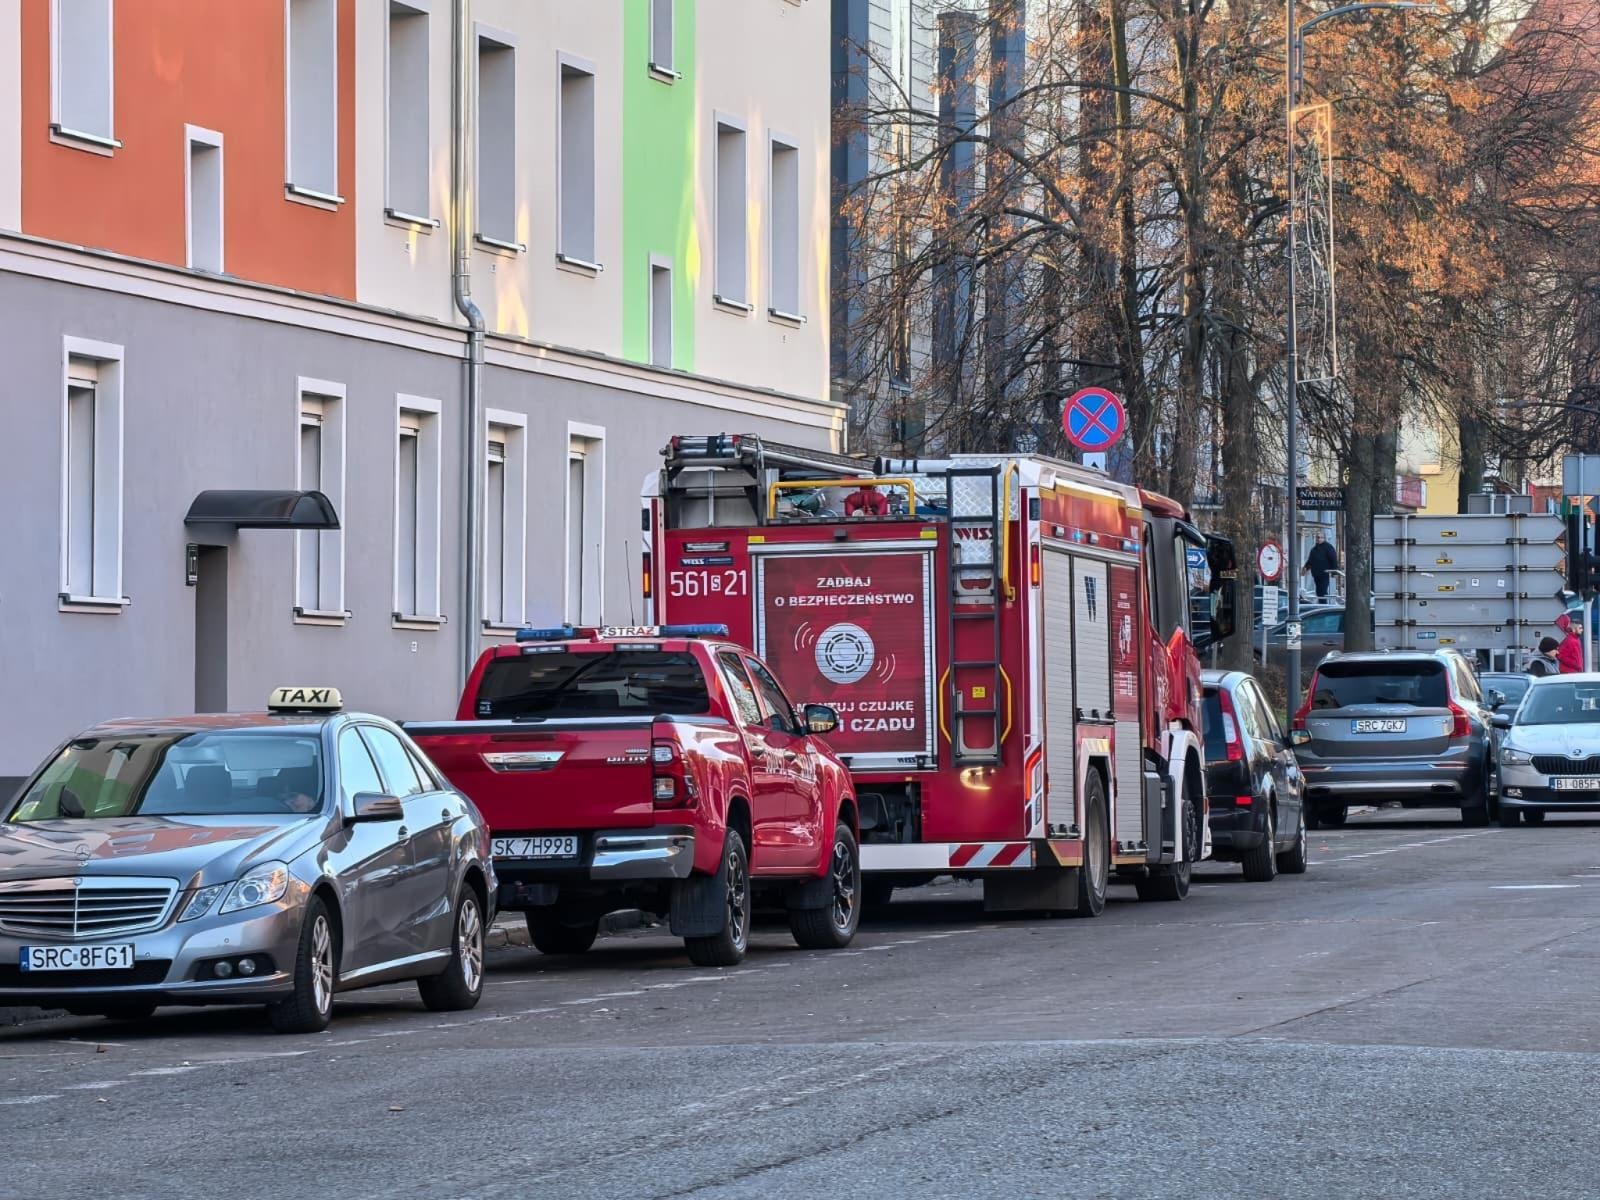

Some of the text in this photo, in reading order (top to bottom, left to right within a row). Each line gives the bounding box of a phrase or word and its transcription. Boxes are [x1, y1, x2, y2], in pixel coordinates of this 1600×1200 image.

[670, 571, 708, 597] 561
[724, 570, 747, 596] 21
[816, 577, 872, 588] ZADBAJ
[774, 592, 915, 607] O BEZPIECZEŃSTWO
[279, 689, 331, 703] TAXI
[858, 701, 915, 714] CZUJKĘ
[850, 718, 916, 732] CZADU
[1358, 719, 1406, 731] SRC 7GK7
[495, 838, 573, 855] SK 7H998
[32, 946, 128, 968] SRC 8FG1
